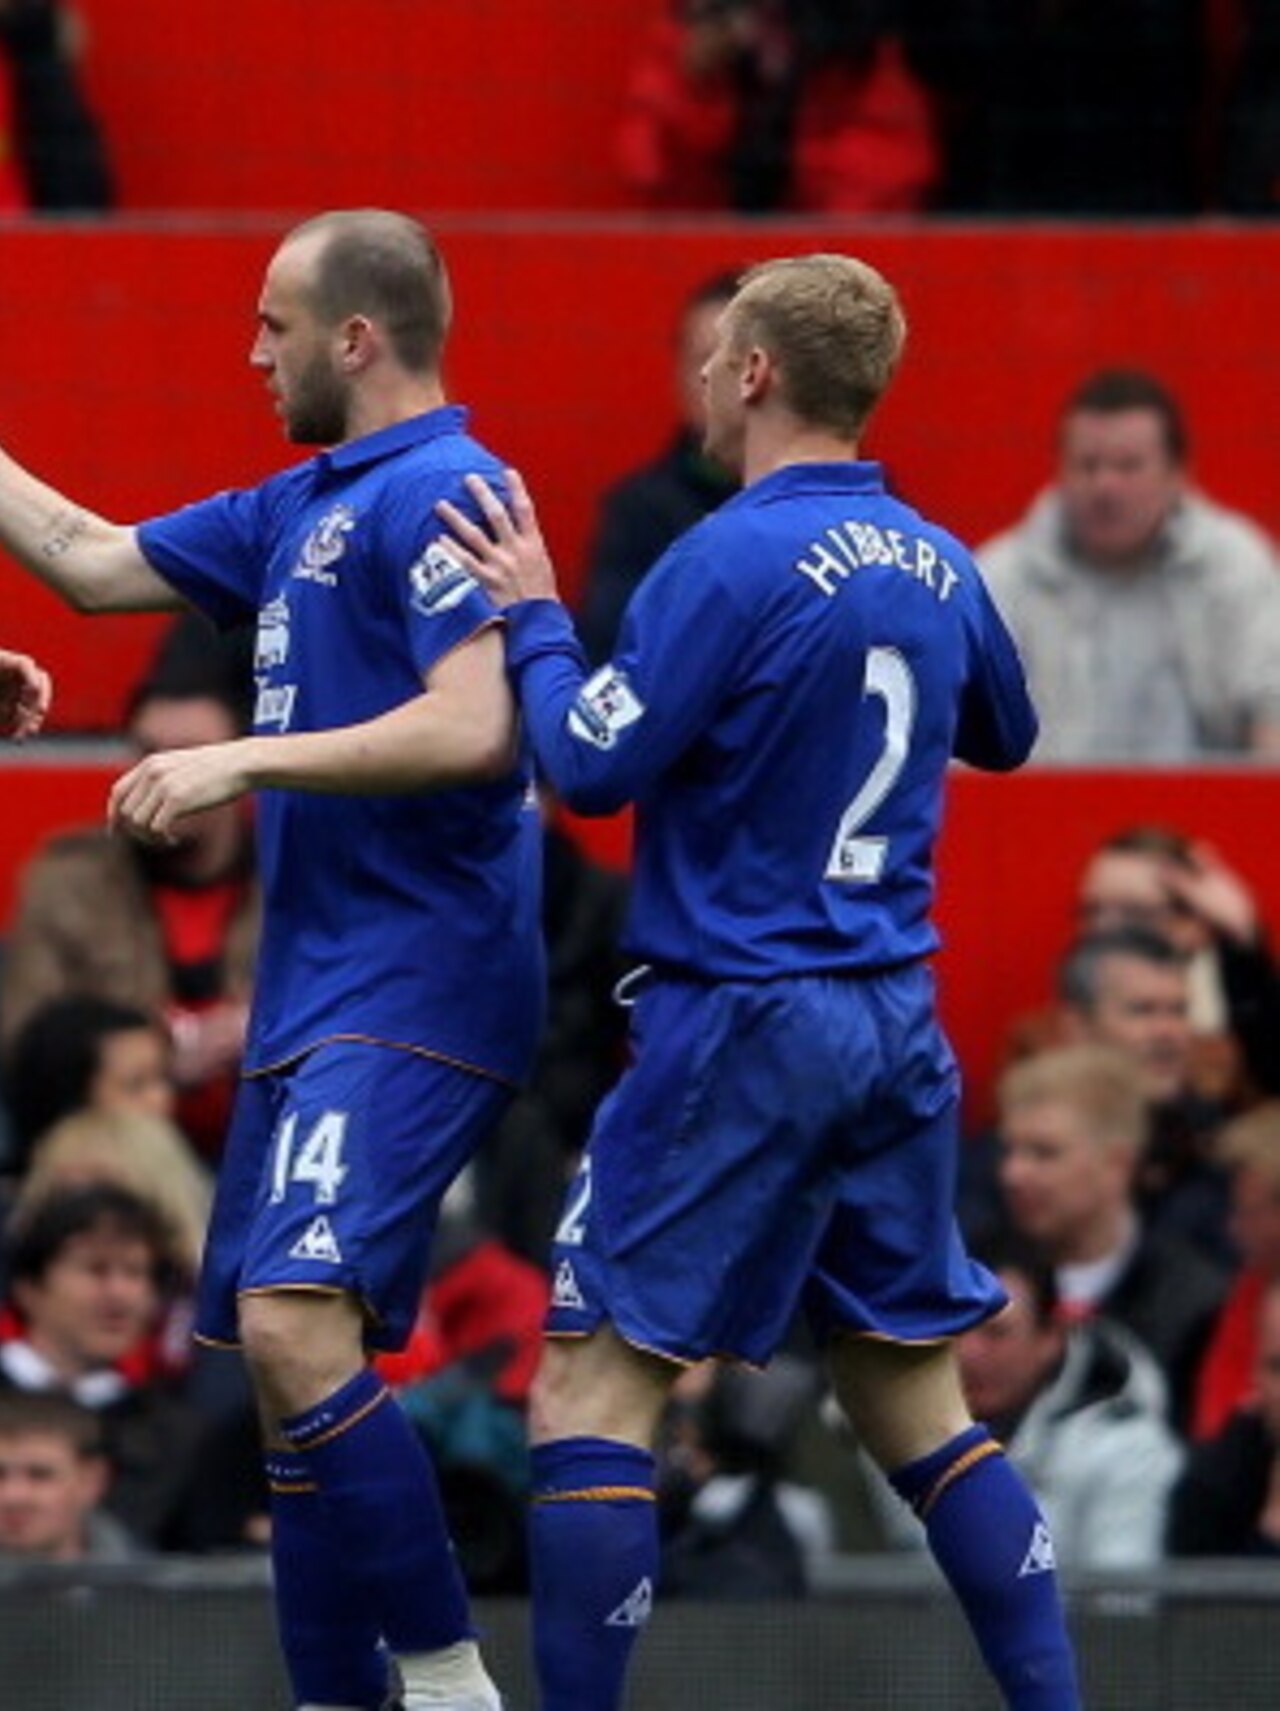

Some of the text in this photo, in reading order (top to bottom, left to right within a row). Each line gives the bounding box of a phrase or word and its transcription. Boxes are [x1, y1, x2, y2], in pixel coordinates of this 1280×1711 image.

[796, 520, 959, 601] HIBBERT
[824, 646, 915, 883] 2
[269, 1111, 350, 1205] 14
[555, 1153, 592, 1246] 2
